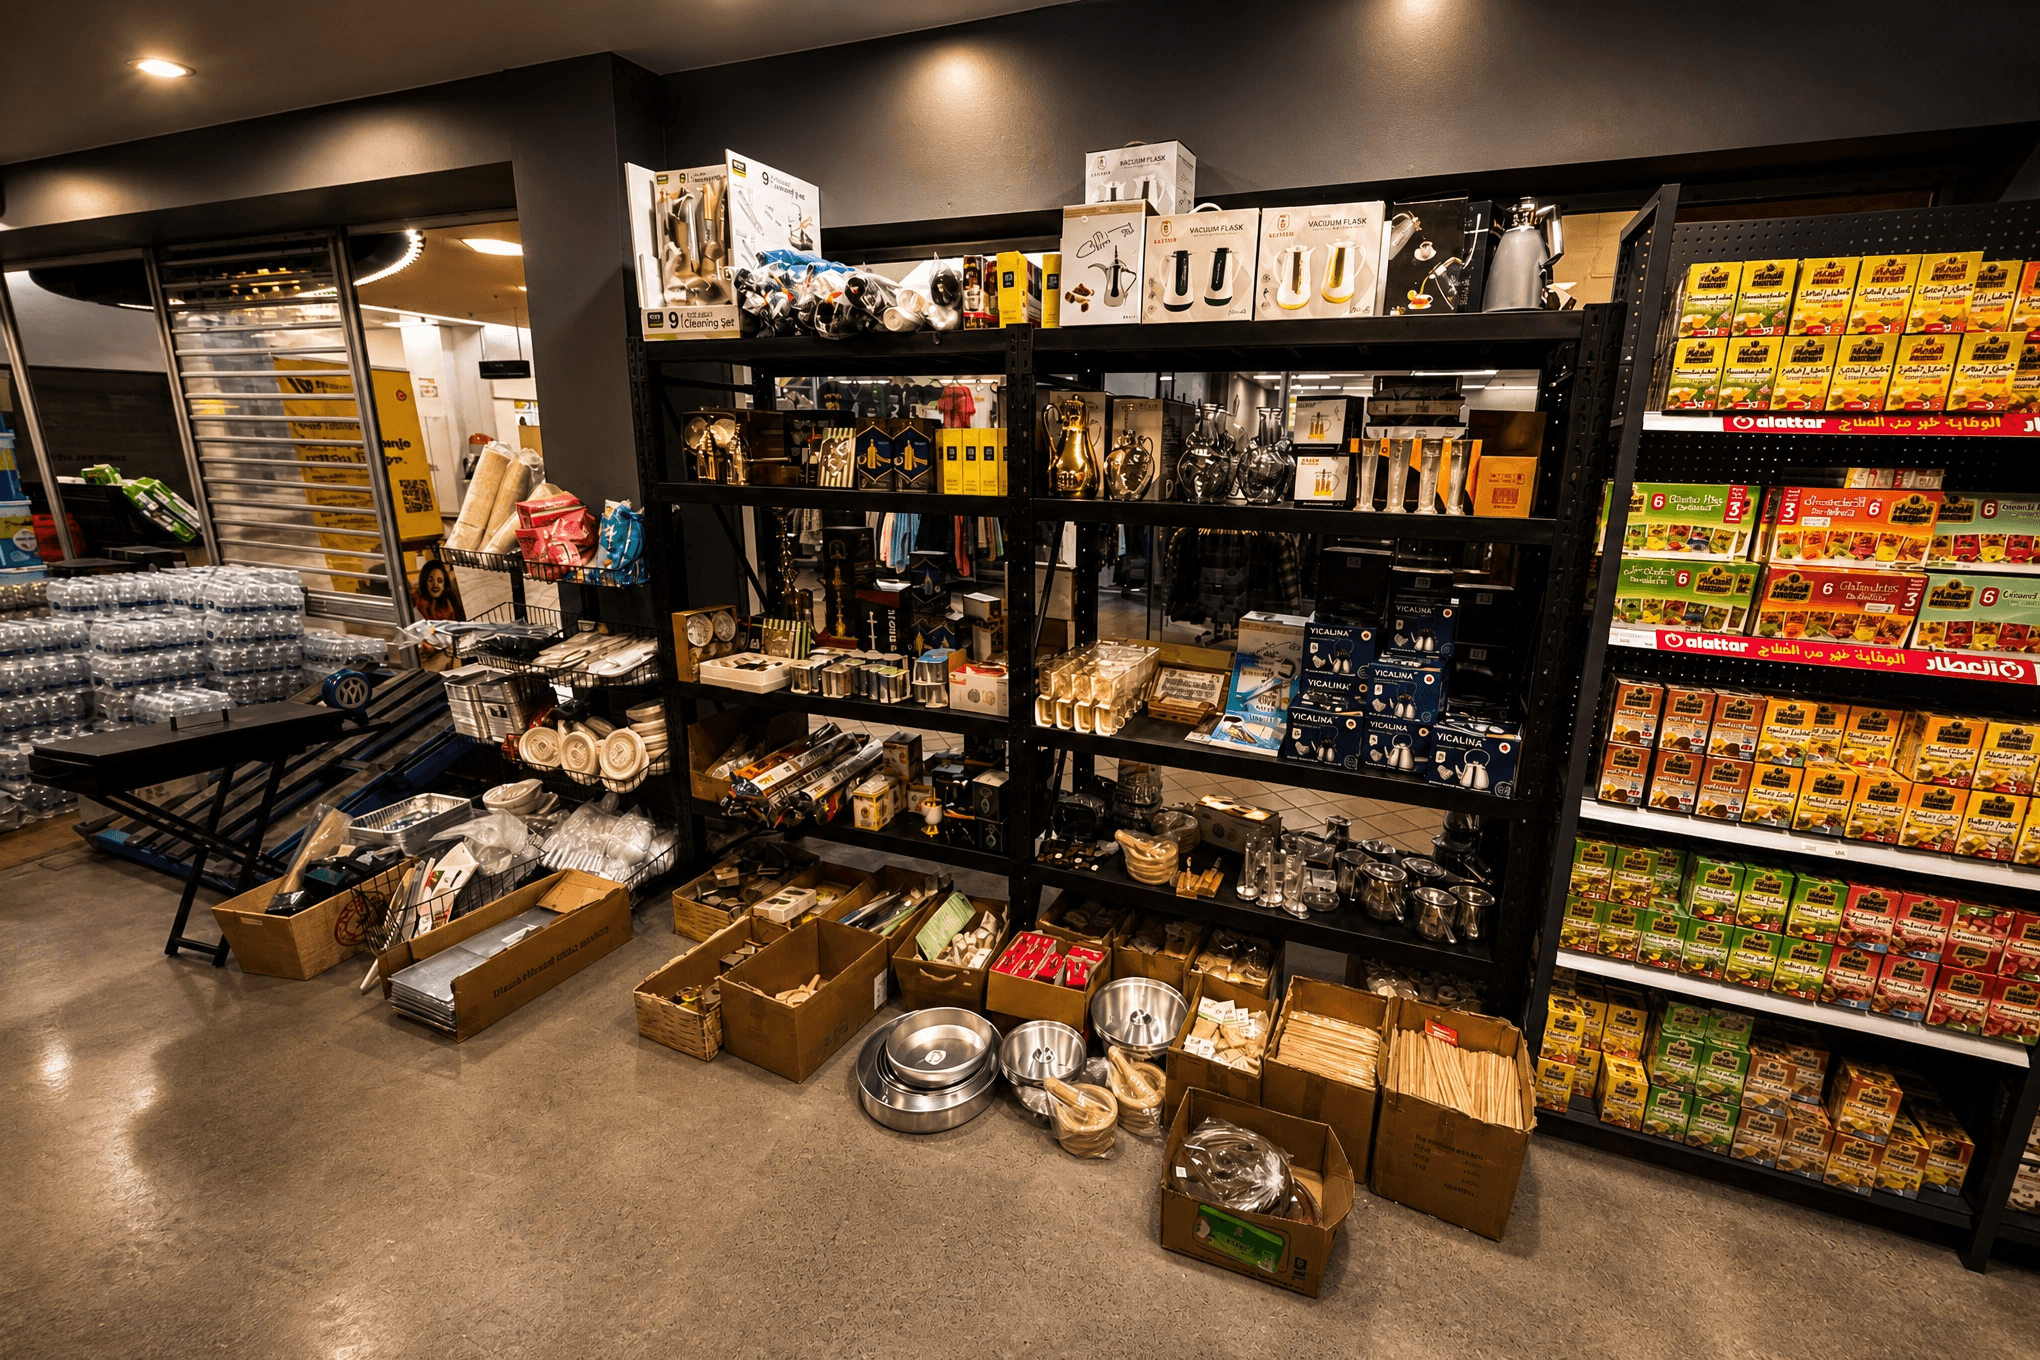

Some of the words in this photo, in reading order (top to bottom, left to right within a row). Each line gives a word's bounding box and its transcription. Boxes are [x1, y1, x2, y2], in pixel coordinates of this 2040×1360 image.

[1120, 157, 1145, 166] VACUUM
[1146, 155, 1166, 163] FLASK
[762, 172, 769, 185] 9
[1308, 219, 1341, 227] VACUUM
[1343, 217, 1367, 225] FLASK
[1190, 225, 1219, 233] VACUUM
[669, 312, 679, 328] 9
[684, 319, 718, 329] Cleaning
[721, 318, 734, 328] Set
[1757, 417, 1826, 429] alattar
[1653, 495, 1664, 507] 6
[1729, 501, 1741, 516] 3
[1783, 502, 1796, 518] 3
[1868, 502, 1880, 516] 6
[1984, 502, 1995, 515] 6
[1677, 572, 1688, 584] 6
[1822, 583, 1834, 595] 6
[1904, 592, 1918, 608] 3
[1983, 590, 1995, 603] 6
[1686, 637, 1749, 653] alattar
